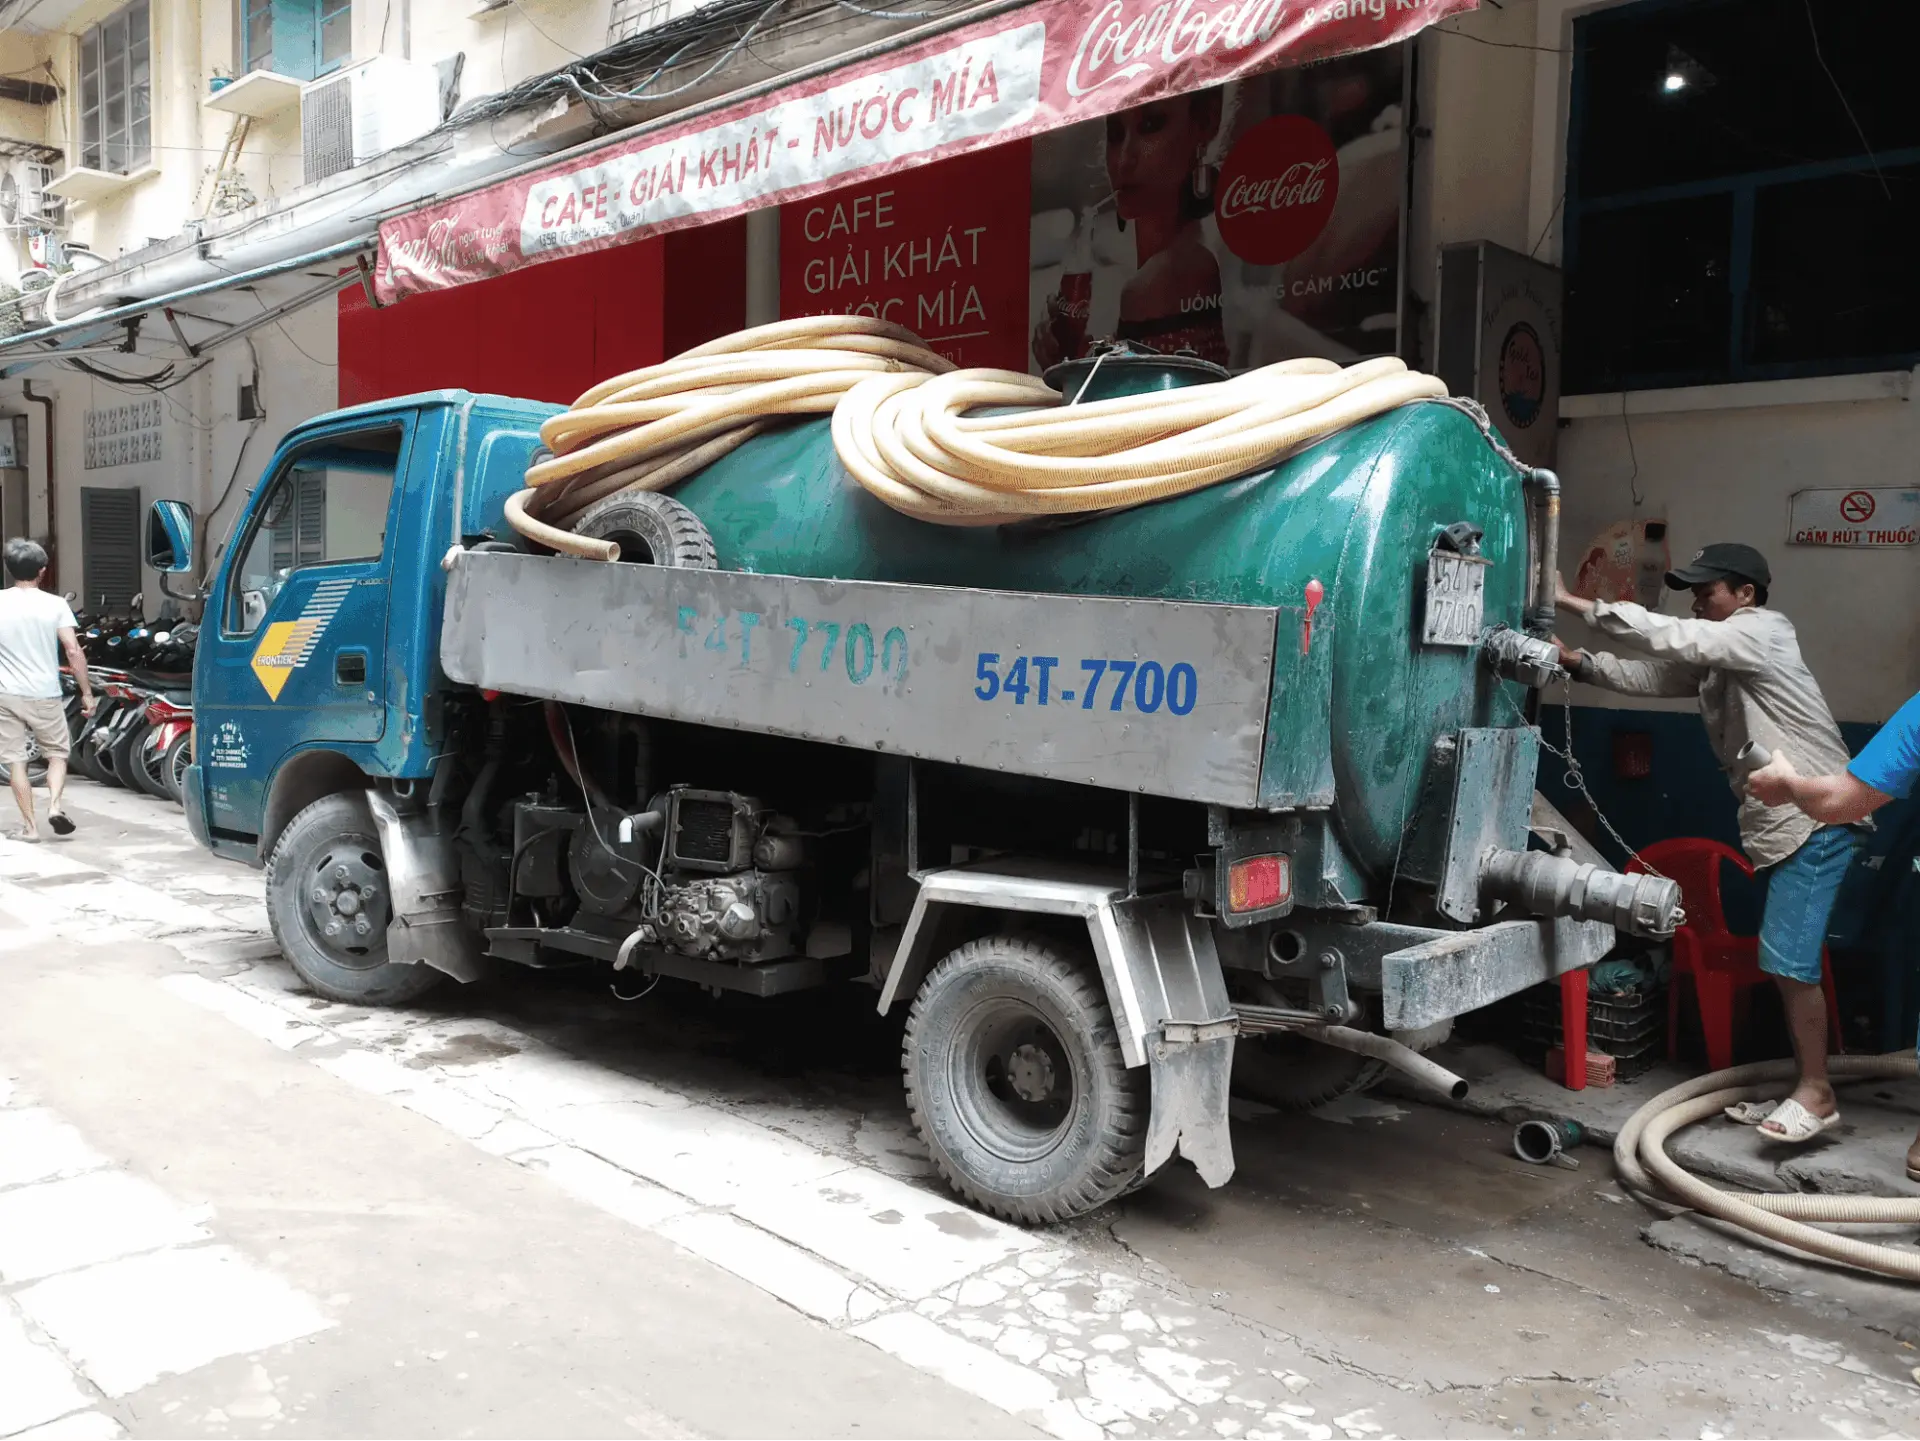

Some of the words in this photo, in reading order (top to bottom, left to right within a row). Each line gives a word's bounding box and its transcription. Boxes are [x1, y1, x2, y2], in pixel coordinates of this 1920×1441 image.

[1066, 0, 1286, 96] Coca-Cola
[698, 126, 779, 189] KHÁT
[813, 85, 918, 157] NƯỚC
[929, 56, 999, 123] MÍA
[804, 190, 894, 242] CAFE
[1221, 157, 1333, 219] Coca-Cola
[804, 244, 869, 294] GIẢI
[884, 225, 986, 280] KHÁT
[917, 281, 986, 329] MÍA
[1796, 526, 1828, 544] CẤM
[1832, 527, 1862, 544] HÚT
[1867, 525, 1917, 544] THUỐC
[1433, 600, 1477, 639] 7700
[256, 654, 295, 666] FRONTIER
[974, 652, 1198, 716] 54T-7700
